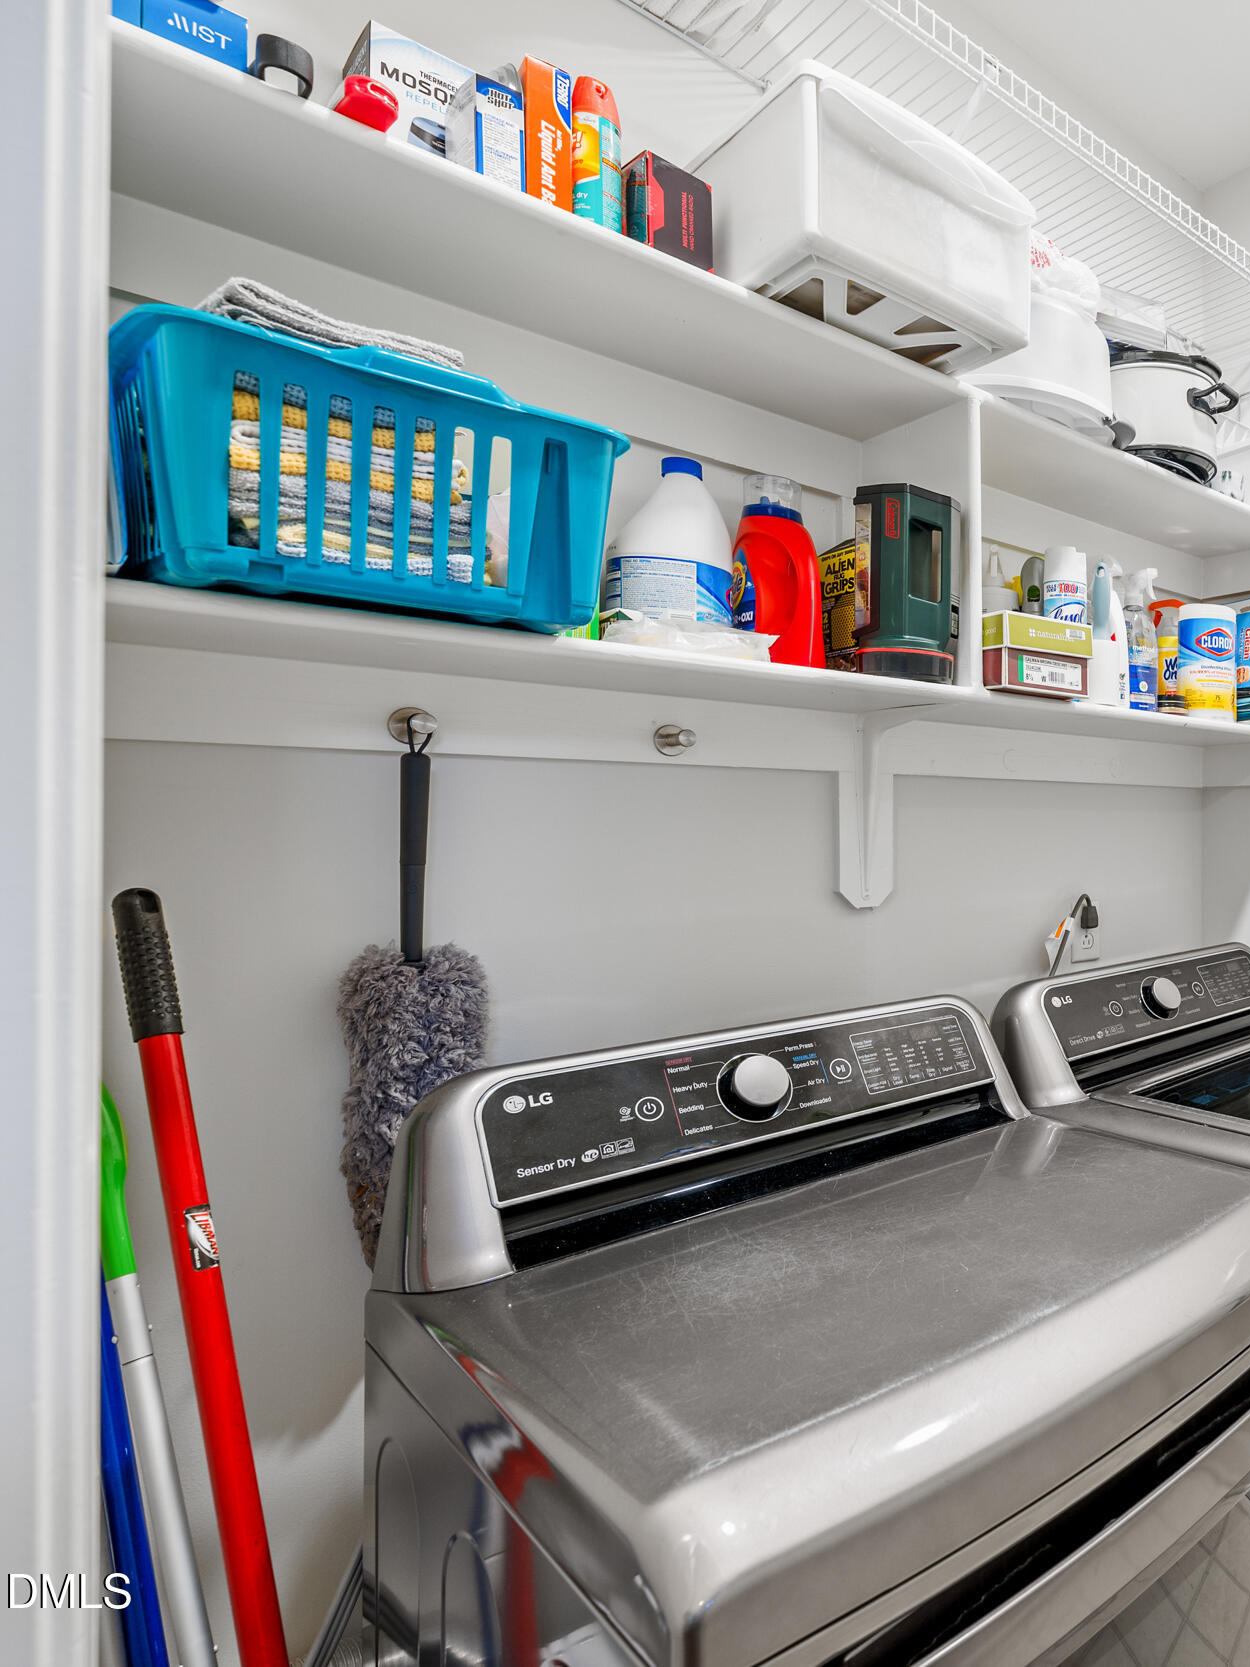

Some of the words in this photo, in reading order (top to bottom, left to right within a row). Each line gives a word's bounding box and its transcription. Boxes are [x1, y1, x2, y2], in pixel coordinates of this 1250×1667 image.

[489, 88, 512, 102] HOT
[556, 74, 570, 110] TERRO
[487, 96, 515, 110] SHOT
[538, 120, 556, 166] Liquid
[541, 163, 556, 189] Ant
[541, 187, 556, 209] Ba
[825, 557, 855, 577] ALIEN
[825, 577, 855, 596] GRIPS
[1132, 644, 1156, 653] method
[1201, 635, 1233, 650] CLOROX
[1163, 669, 1177, 681] On
[1060, 995, 1073, 1005] LG
[667, 1065, 690, 1074] Normal
[792, 1061, 809, 1069] Speed
[672, 1084, 692, 1093] Heavy
[693, 1081, 708, 1090] Duty
[528, 1092, 554, 1108] LG
[679, 1104, 705, 1114] Bedding
[684, 1124, 714, 1136] Delicates
[516, 1161, 555, 1178] Sensor
[556, 1157, 576, 1169] Dry
[190, 1212, 219, 1255] LIBMAN
